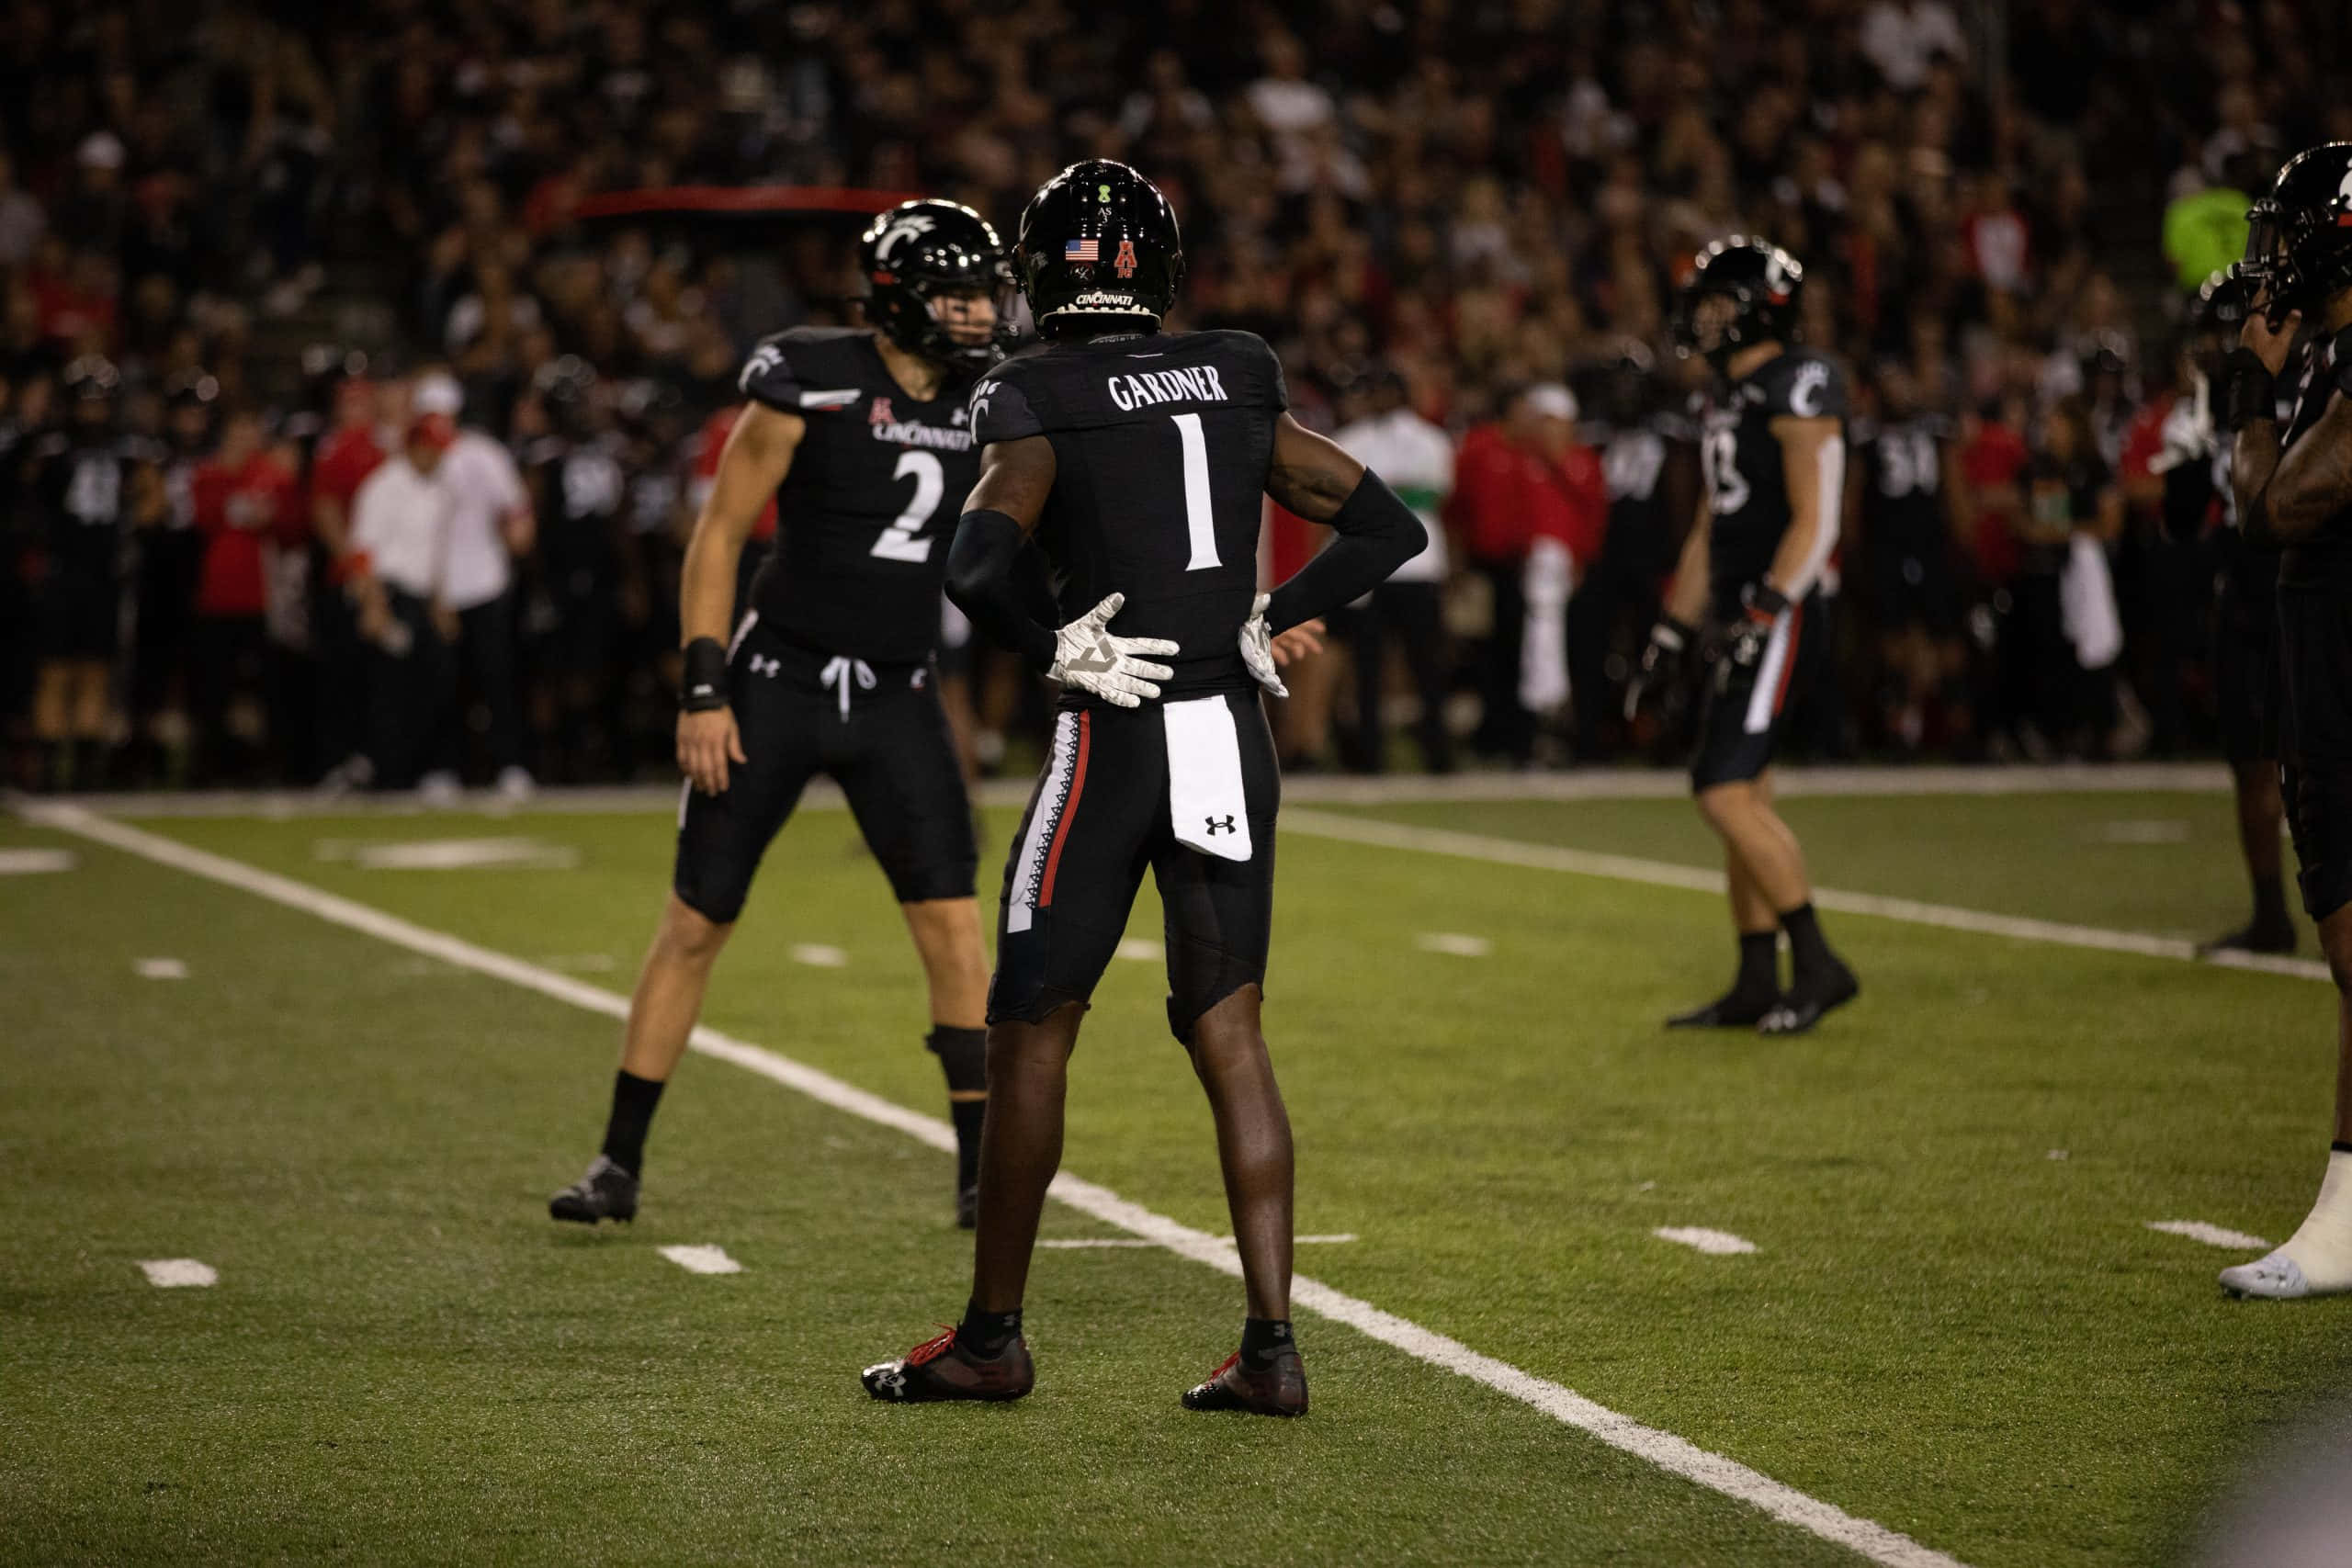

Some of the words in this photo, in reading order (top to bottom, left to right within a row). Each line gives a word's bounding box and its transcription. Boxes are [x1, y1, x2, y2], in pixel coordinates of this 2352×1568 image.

[1075, 291, 1134, 306] CINCINNATI
[1107, 366, 1228, 412] GARDNER
[872, 419, 972, 451] CINCINNATI
[869, 450, 945, 562] 2
[1170, 412, 1223, 571] 1
